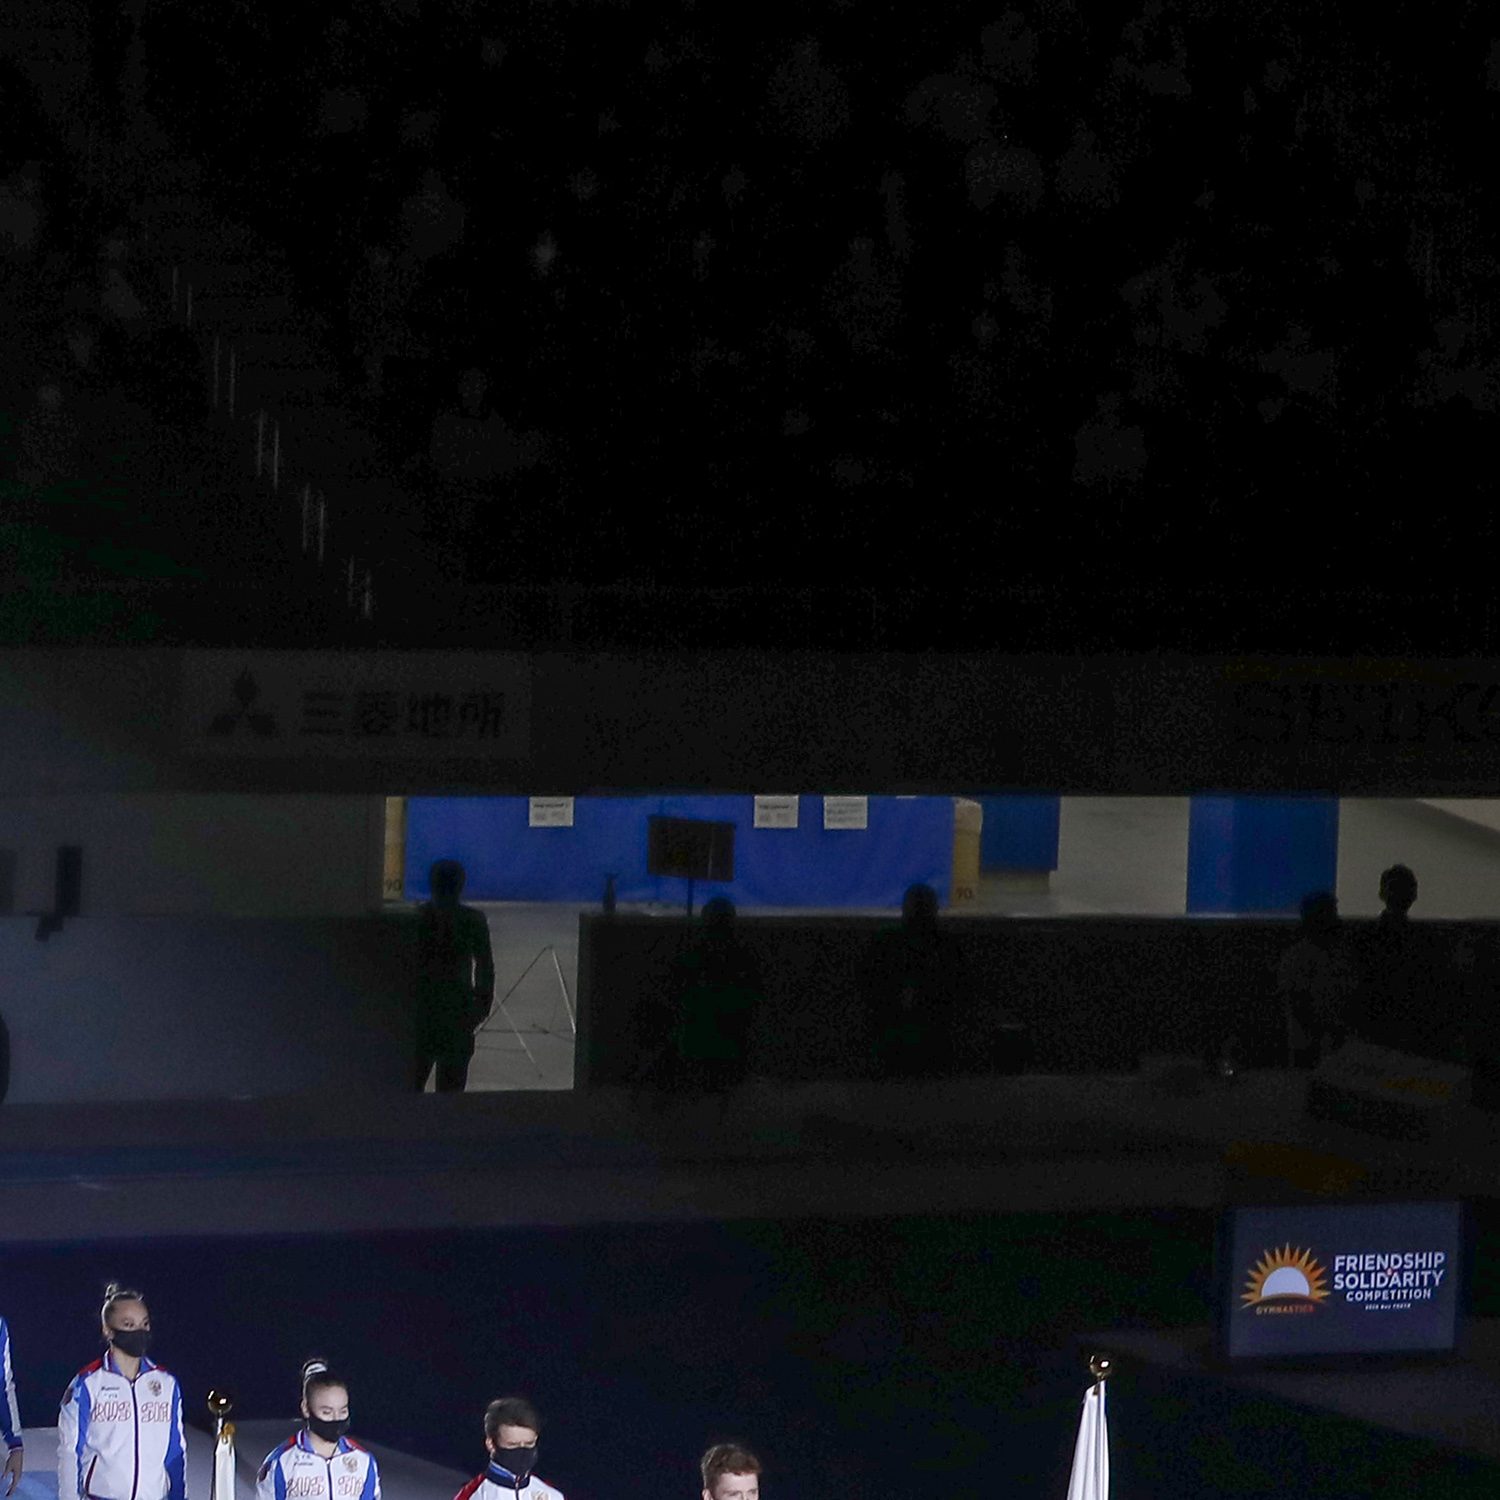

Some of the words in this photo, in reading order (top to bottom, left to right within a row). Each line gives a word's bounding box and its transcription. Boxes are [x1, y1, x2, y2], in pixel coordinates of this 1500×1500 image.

[300, 684, 506, 740] 三菱地所
[1334, 1251, 1446, 1273] FRIENDSHIP
[1333, 1269, 1445, 1291] SOLIDARITY
[1345, 1288, 1432, 1303] COMPETITION
